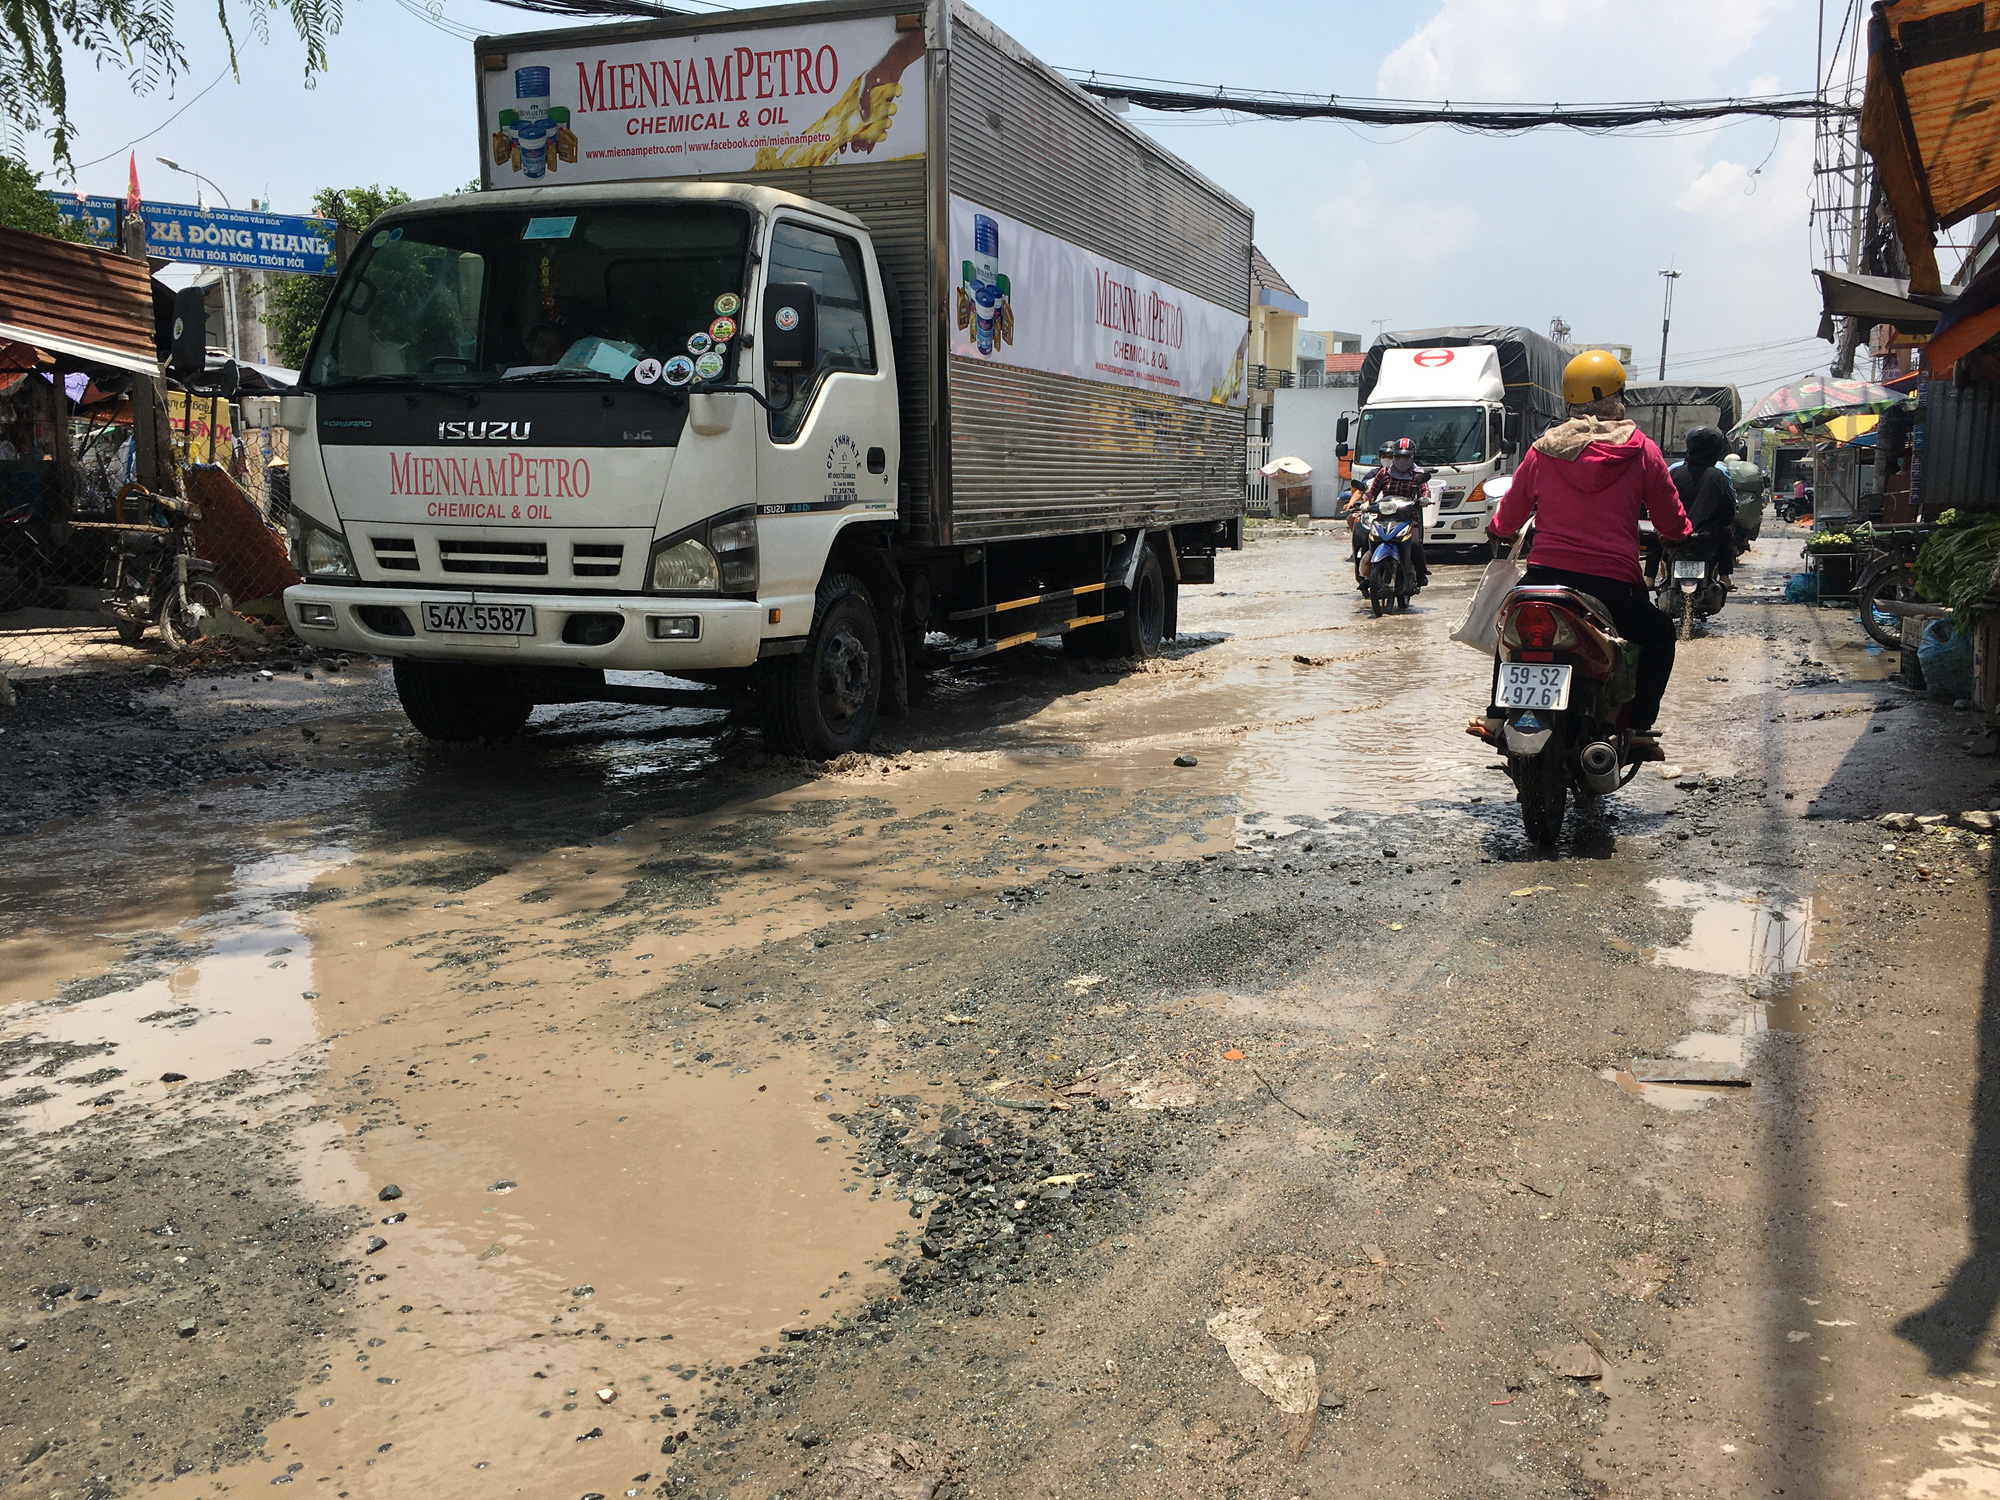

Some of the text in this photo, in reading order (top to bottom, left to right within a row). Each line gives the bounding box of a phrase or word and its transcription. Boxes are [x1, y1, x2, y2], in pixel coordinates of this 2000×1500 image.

[576, 44, 839, 113] MIENNAMPETRO
[626, 106, 789, 136] CHEMICAL & OIL
[585, 142, 683, 160] www.miennampetro.com
[688, 132, 831, 152] www.facebook.com/miennampetro
[151, 220, 184, 243] XÃ
[188, 223, 253, 249] ĐÔNG
[257, 231, 330, 256] THẠNH
[145, 243, 167, 256] ÔNG
[184, 247, 204, 259] VĂN
[206, 248, 227, 261] HÓA
[229, 251, 257, 264] NÔNG
[258, 254, 285, 267] THÔN
[286, 257, 305, 269] MỚI
[1095, 267, 1183, 350] MIENNAMPETRO
[1113, 340, 1168, 370] CHEMICAL & OIL
[437, 420, 532, 440] ISUZU
[389, 452, 590, 498] MIENNAMPETRO
[426, 502, 552, 520] CHEMICAL & OIL
[763, 505, 786, 514] ISUZU
[430, 605, 527, 632] 54X-5587
[1509, 666, 1561, 687] 59-S2
[1500, 686, 1562, 707] 497.61
